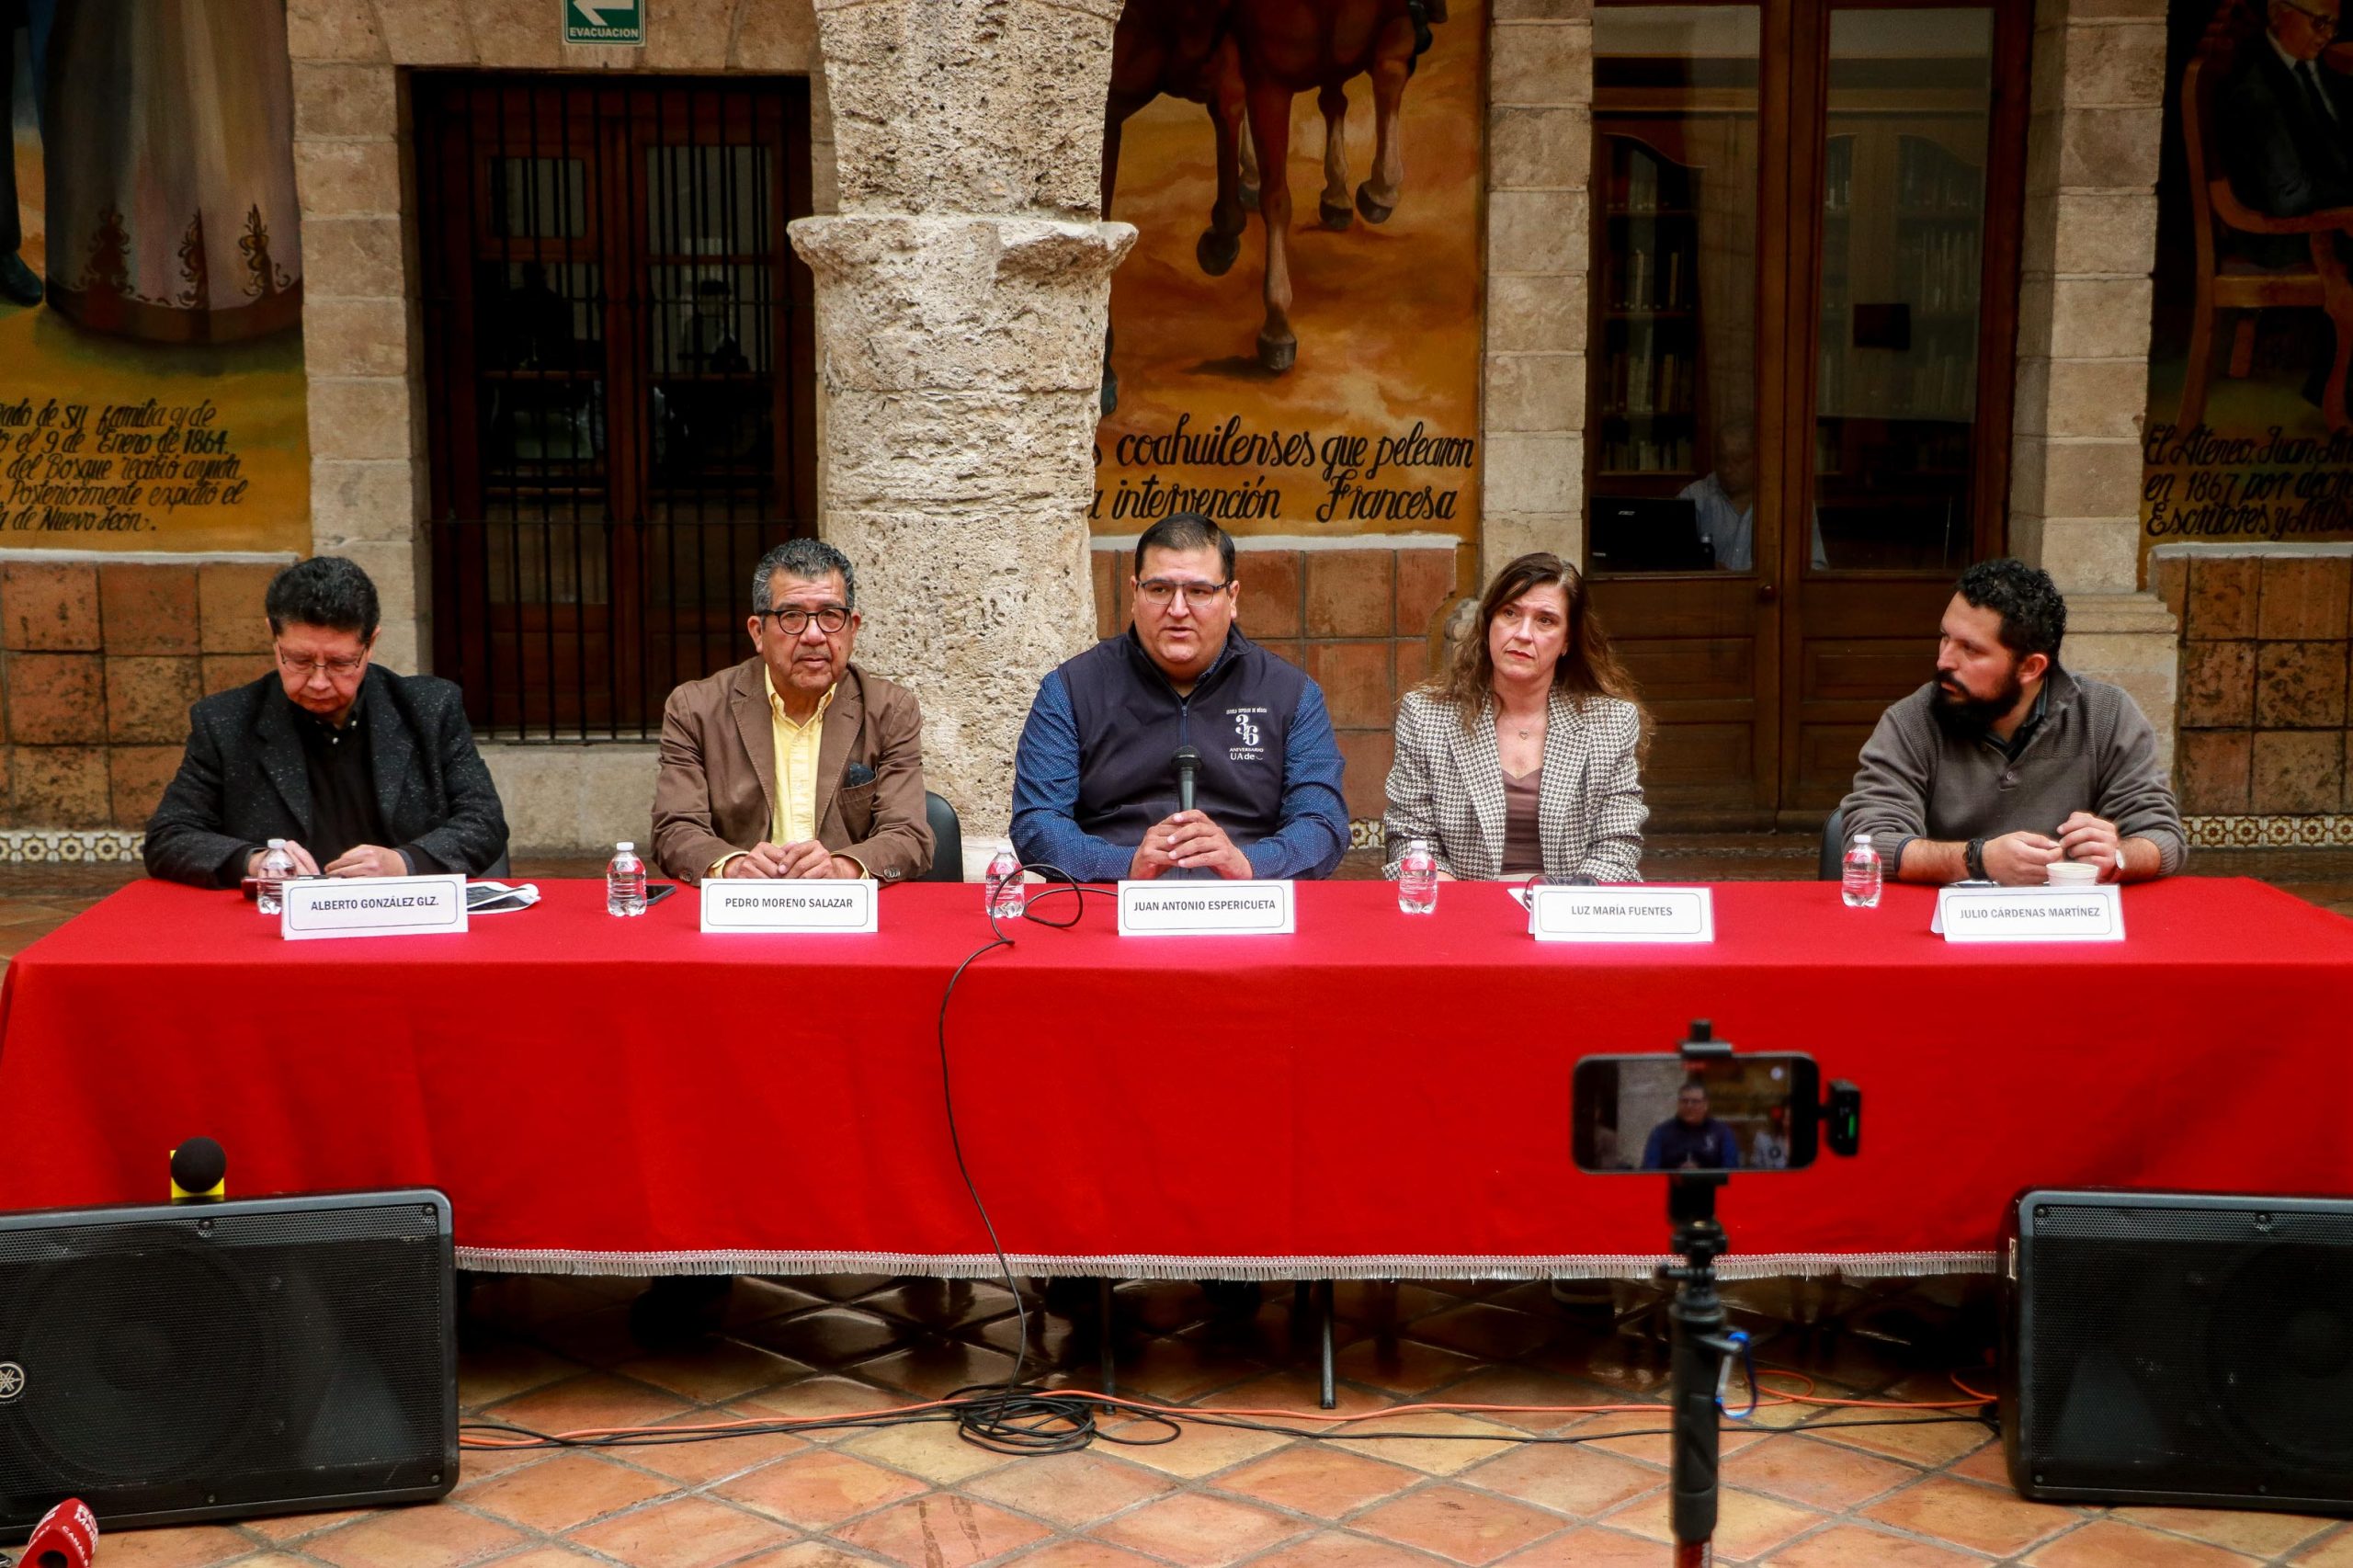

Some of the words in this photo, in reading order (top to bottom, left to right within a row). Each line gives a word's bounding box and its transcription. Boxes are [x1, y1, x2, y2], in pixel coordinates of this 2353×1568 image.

[569, 27, 639, 38] EVACUACION
[36, 398, 60, 428] de
[97, 398, 168, 437] familia
[188, 399, 217, 428] de
[16, 429, 40, 454] el
[40, 430, 60, 455] 9
[62, 429, 86, 454] de
[97, 428, 153, 455] Enero
[156, 426, 178, 454] de
[1116, 412, 1315, 468] coahuilenses
[1321, 434, 1366, 481] que
[1365, 420, 1475, 481] pelearon
[6, 453, 40, 480] del
[46, 454, 112, 485] Bosque
[7, 480, 143, 506] Posteriormente
[222, 479, 249, 506] el
[1111, 472, 1281, 520] intervención
[1315, 468, 1460, 524] Francesa
[2184, 470, 2240, 503] 1867
[2239, 470, 2294, 506] por
[12, 507, 38, 531] de
[37, 506, 96, 531] Nuevo
[1235, 713, 1260, 746] 36
[311, 899, 358, 911] ALBERTO
[360, 895, 415, 909] GONZÁLEZ
[416, 896, 439, 907] GLZ.
[725, 897, 759, 908] PEDRO
[762, 898, 807, 908] MORENO
[809, 898, 853, 908] SALAZAR
[1133, 902, 1160, 912] JUAN
[1162, 901, 1206, 911] ANTONIO
[1208, 900, 1276, 910] ESPERICUETA
[1571, 905, 1591, 915] LUZ
[1593, 903, 1626, 915] MARÍA
[1629, 906, 1673, 916] FUENTES
[1960, 909, 1988, 919] JULIO
[1991, 906, 2046, 918] CÁRDENAS
[2049, 905, 2100, 917] MARTÍNEZ
